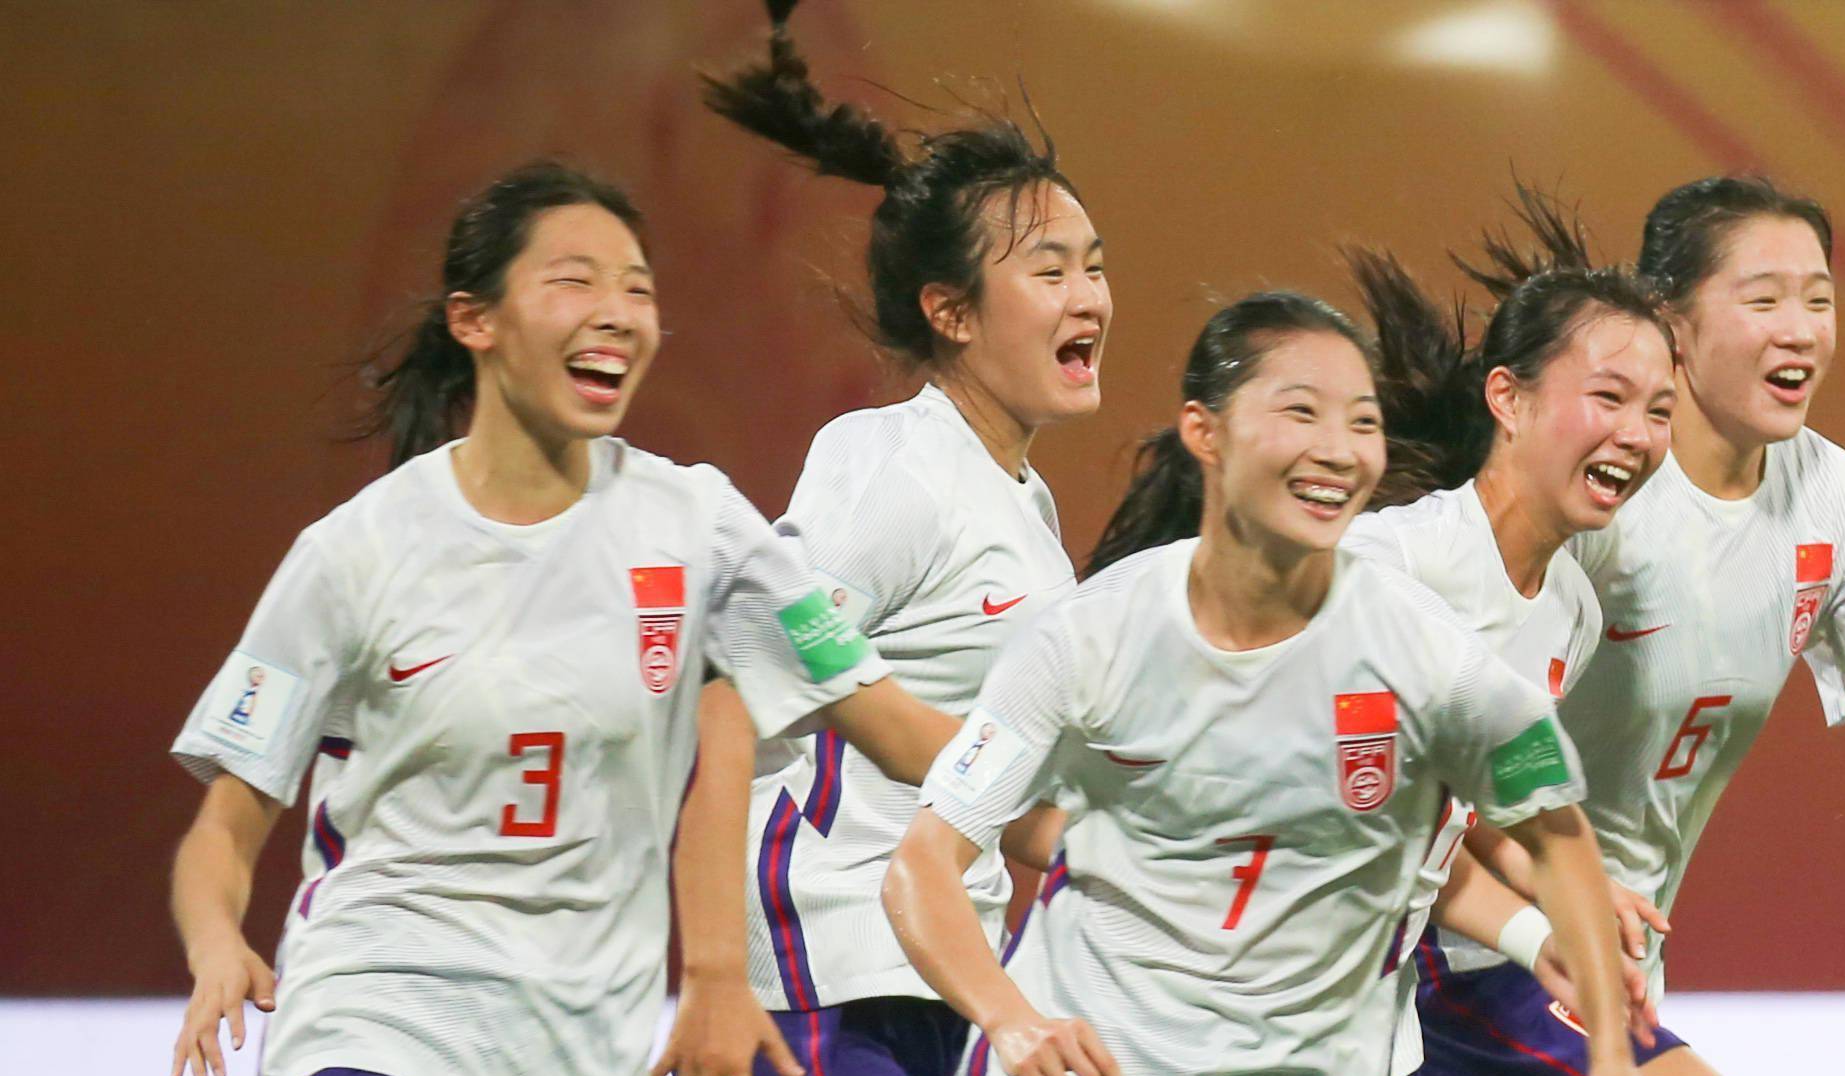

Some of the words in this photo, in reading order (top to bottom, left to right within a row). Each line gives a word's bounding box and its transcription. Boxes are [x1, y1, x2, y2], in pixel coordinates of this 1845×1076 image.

[498, 731, 565, 837] 3
[1653, 695, 1732, 781] 6
[1215, 834, 1276, 930] 7
